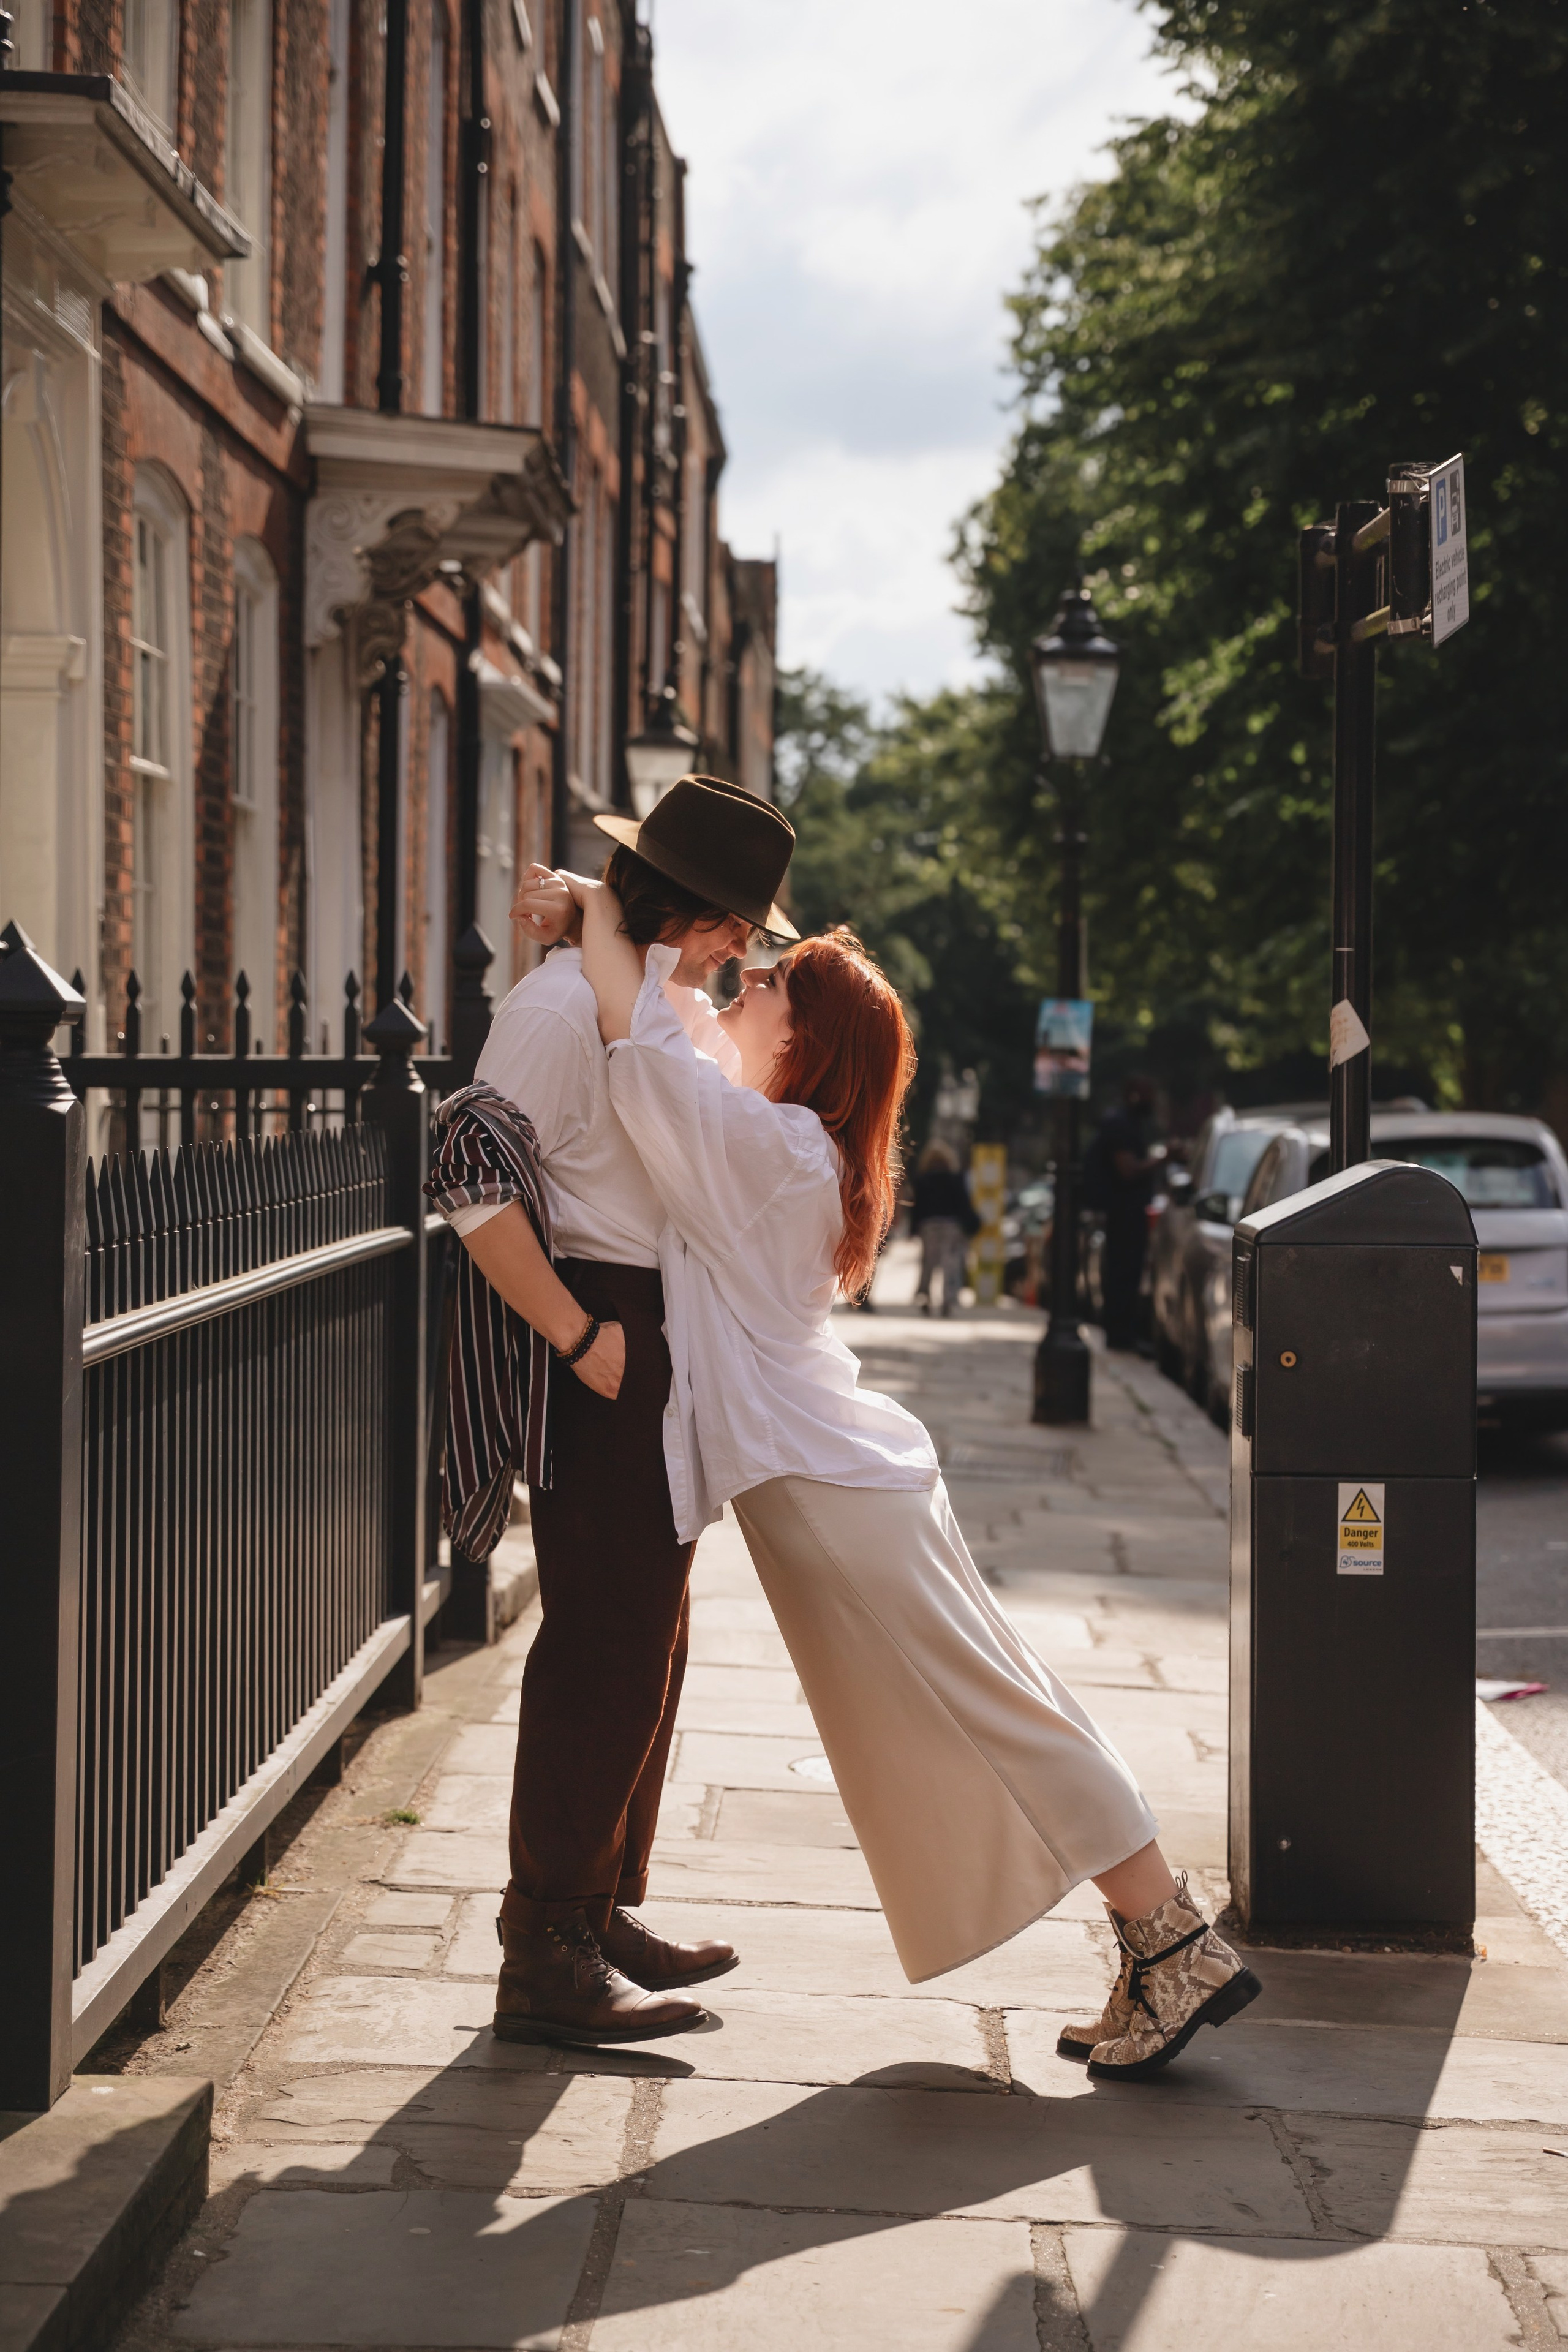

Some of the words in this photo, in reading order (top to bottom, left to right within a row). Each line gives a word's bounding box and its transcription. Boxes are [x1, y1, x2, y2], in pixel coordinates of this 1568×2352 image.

[1438, 487, 1446, 538] P
[1435, 554, 1450, 581] Electric
[1451, 543, 1464, 568] vehicle
[1435, 576, 1456, 606] recharging
[1456, 566, 1467, 594] point
[1447, 600, 1456, 622] only
[1344, 1527, 1378, 1540] Danger
